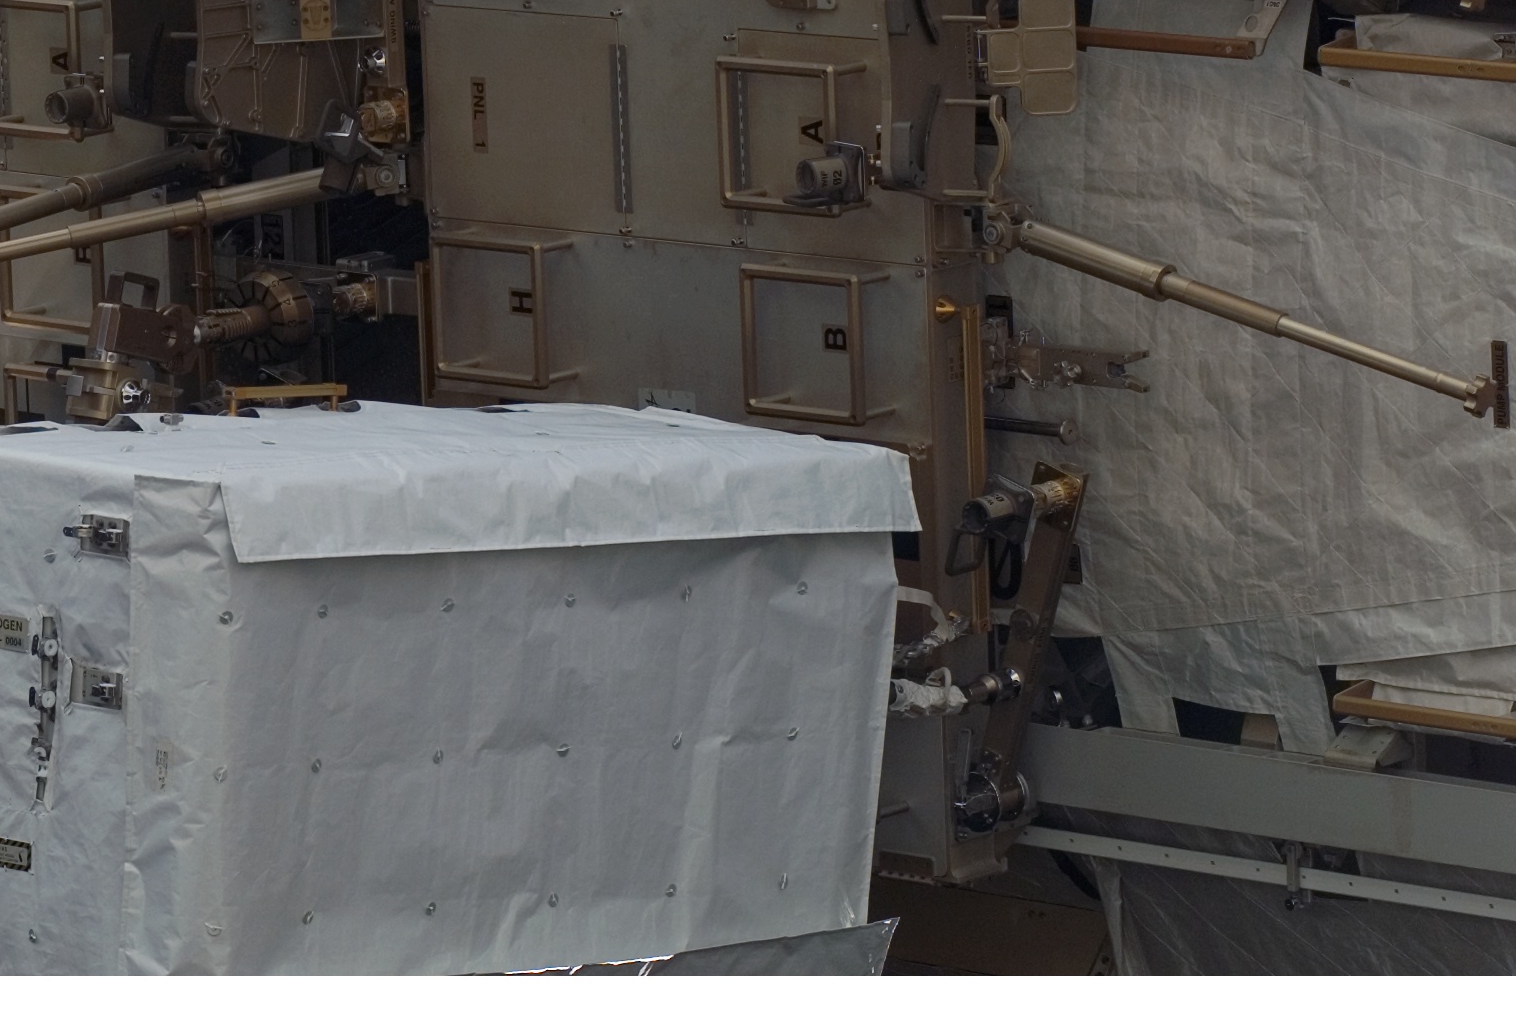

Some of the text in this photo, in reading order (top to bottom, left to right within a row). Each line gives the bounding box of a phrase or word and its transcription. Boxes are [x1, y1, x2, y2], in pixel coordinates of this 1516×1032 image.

[51, 50, 69, 70] A
[472, 81, 485, 121] PNL
[800, 119, 824, 145] A
[510, 290, 533, 314] H
[823, 327, 847, 351] B
[4, 636, 22, 648] 0004
